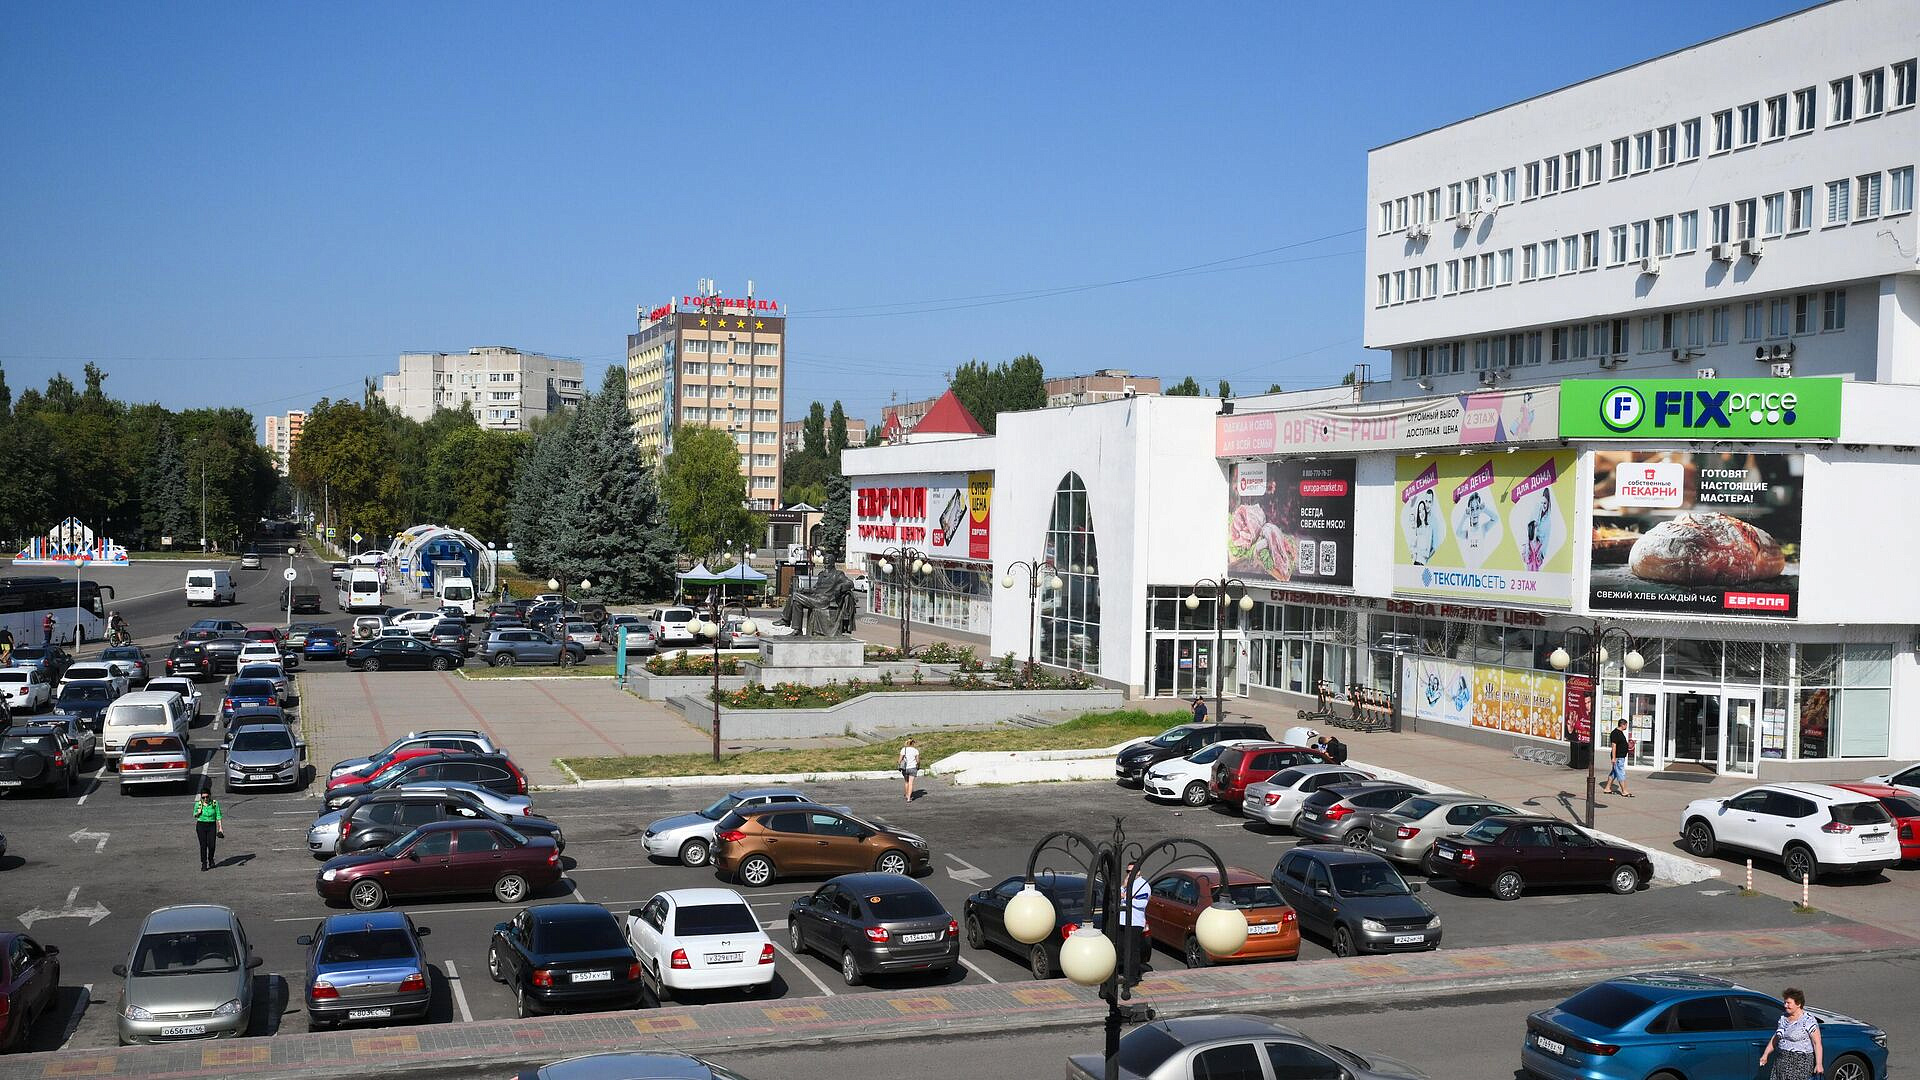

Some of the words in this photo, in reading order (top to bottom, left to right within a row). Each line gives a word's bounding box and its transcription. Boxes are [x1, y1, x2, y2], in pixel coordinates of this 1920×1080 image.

[683, 296, 778, 310] ГОСТИНИЦА
[1614, 397, 1631, 419] F
[1655, 391, 1731, 428] FIX
[1728, 392, 1797, 414] price
[1407, 409, 1438, 422] ОГРОМНЫЙ
[1440, 409, 1460, 419] ВЫБОР
[1467, 414, 1472, 424] 2
[1473, 412, 1495, 425] ЭТАЖ
[1406, 426, 1440, 438] ДОСТУПНАЯ
[1443, 425, 1459, 434] ЦЕНА
[1470, 468, 1491, 489] ДЕТЕЙ
[1530, 469, 1551, 490] ДОМА
[1701, 469, 1748, 478] ГОТОВЯТ
[972, 482, 988, 495] СУПЕР
[1303, 482, 1343, 494] europa-market.ru
[1622, 486, 1677, 497] ПЕКАРНИ
[1701, 481, 1768, 491] НАСТОЯЩИЕ
[1700, 493, 1754, 503] МАСТЕРА!
[972, 498, 987, 512] ЦЕНА
[1300, 507, 1323, 518] ВСЕГДА
[1300, 519, 1325, 529] СВЕЖЕЕ
[1326, 519, 1346, 529] МЯСО!
[1433, 571, 1505, 589] ТЕКСТИЛЬСЕТЬ
[1511, 580, 1515, 590] 2
[1517, 580, 1537, 591] ЭТАЖ
[1596, 590, 1633, 600] СВЕЖИЙ
[1634, 592, 1657, 600] ХЛЕБ
[1658, 593, 1697, 602] КАЖДЫЙ
[1699, 594, 1717, 603] ЧАС
[1729, 596, 1785, 607] ЕВРОПА
